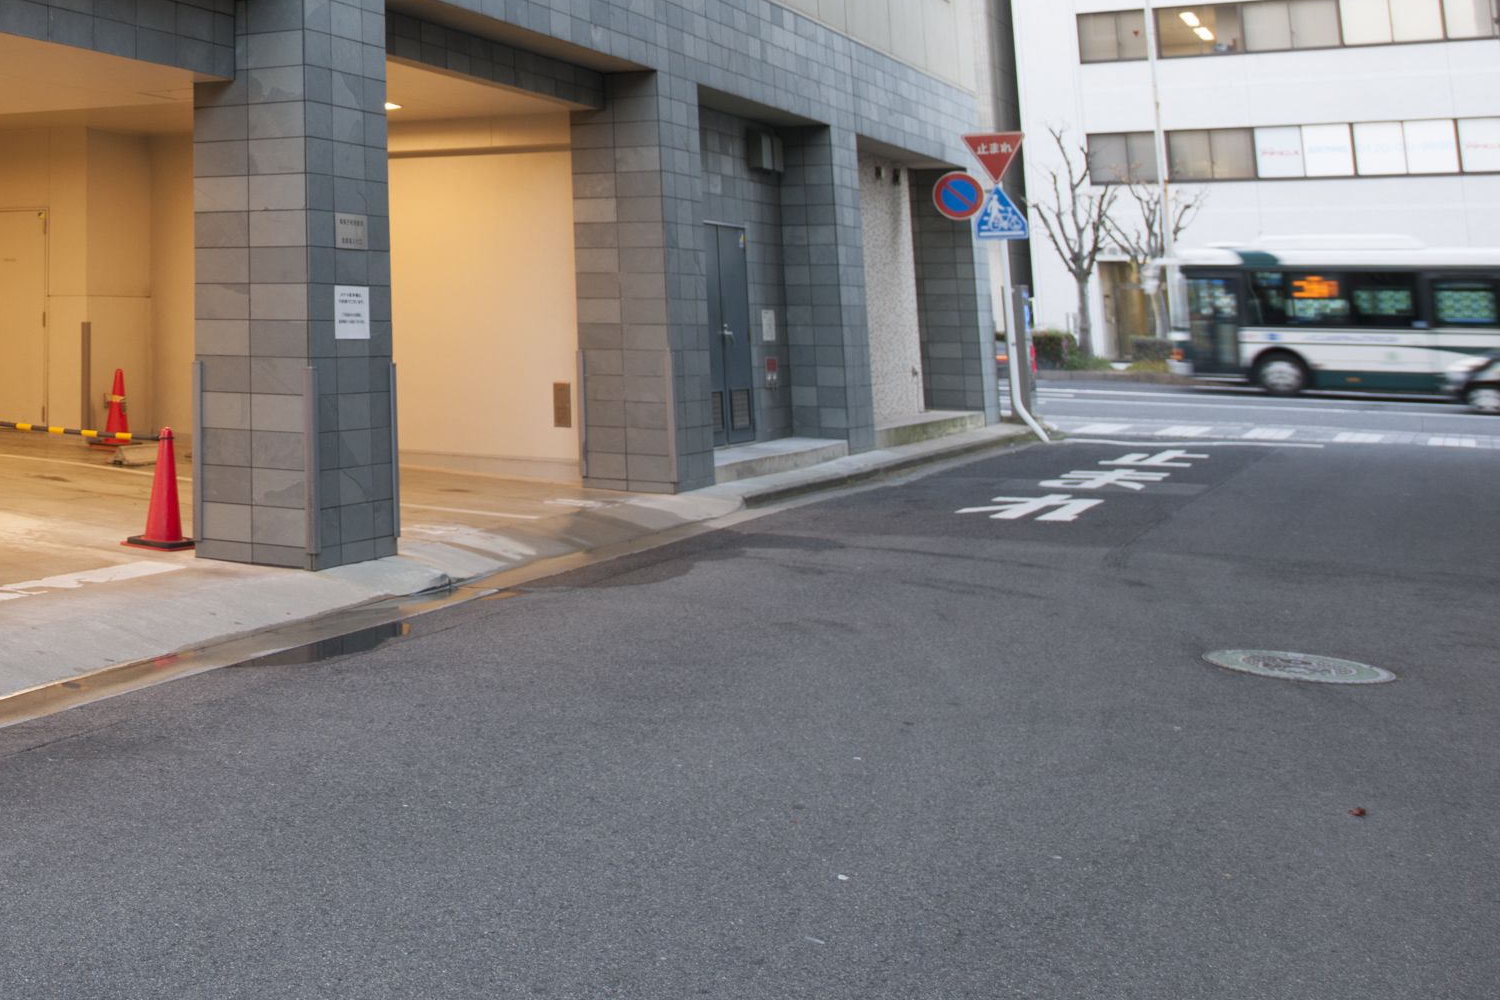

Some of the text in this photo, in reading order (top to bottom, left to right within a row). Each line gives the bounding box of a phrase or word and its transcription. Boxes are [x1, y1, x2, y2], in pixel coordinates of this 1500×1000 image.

[977, 143, 1012, 155] 止まれ
[954, 449, 1210, 522] 止まれ
